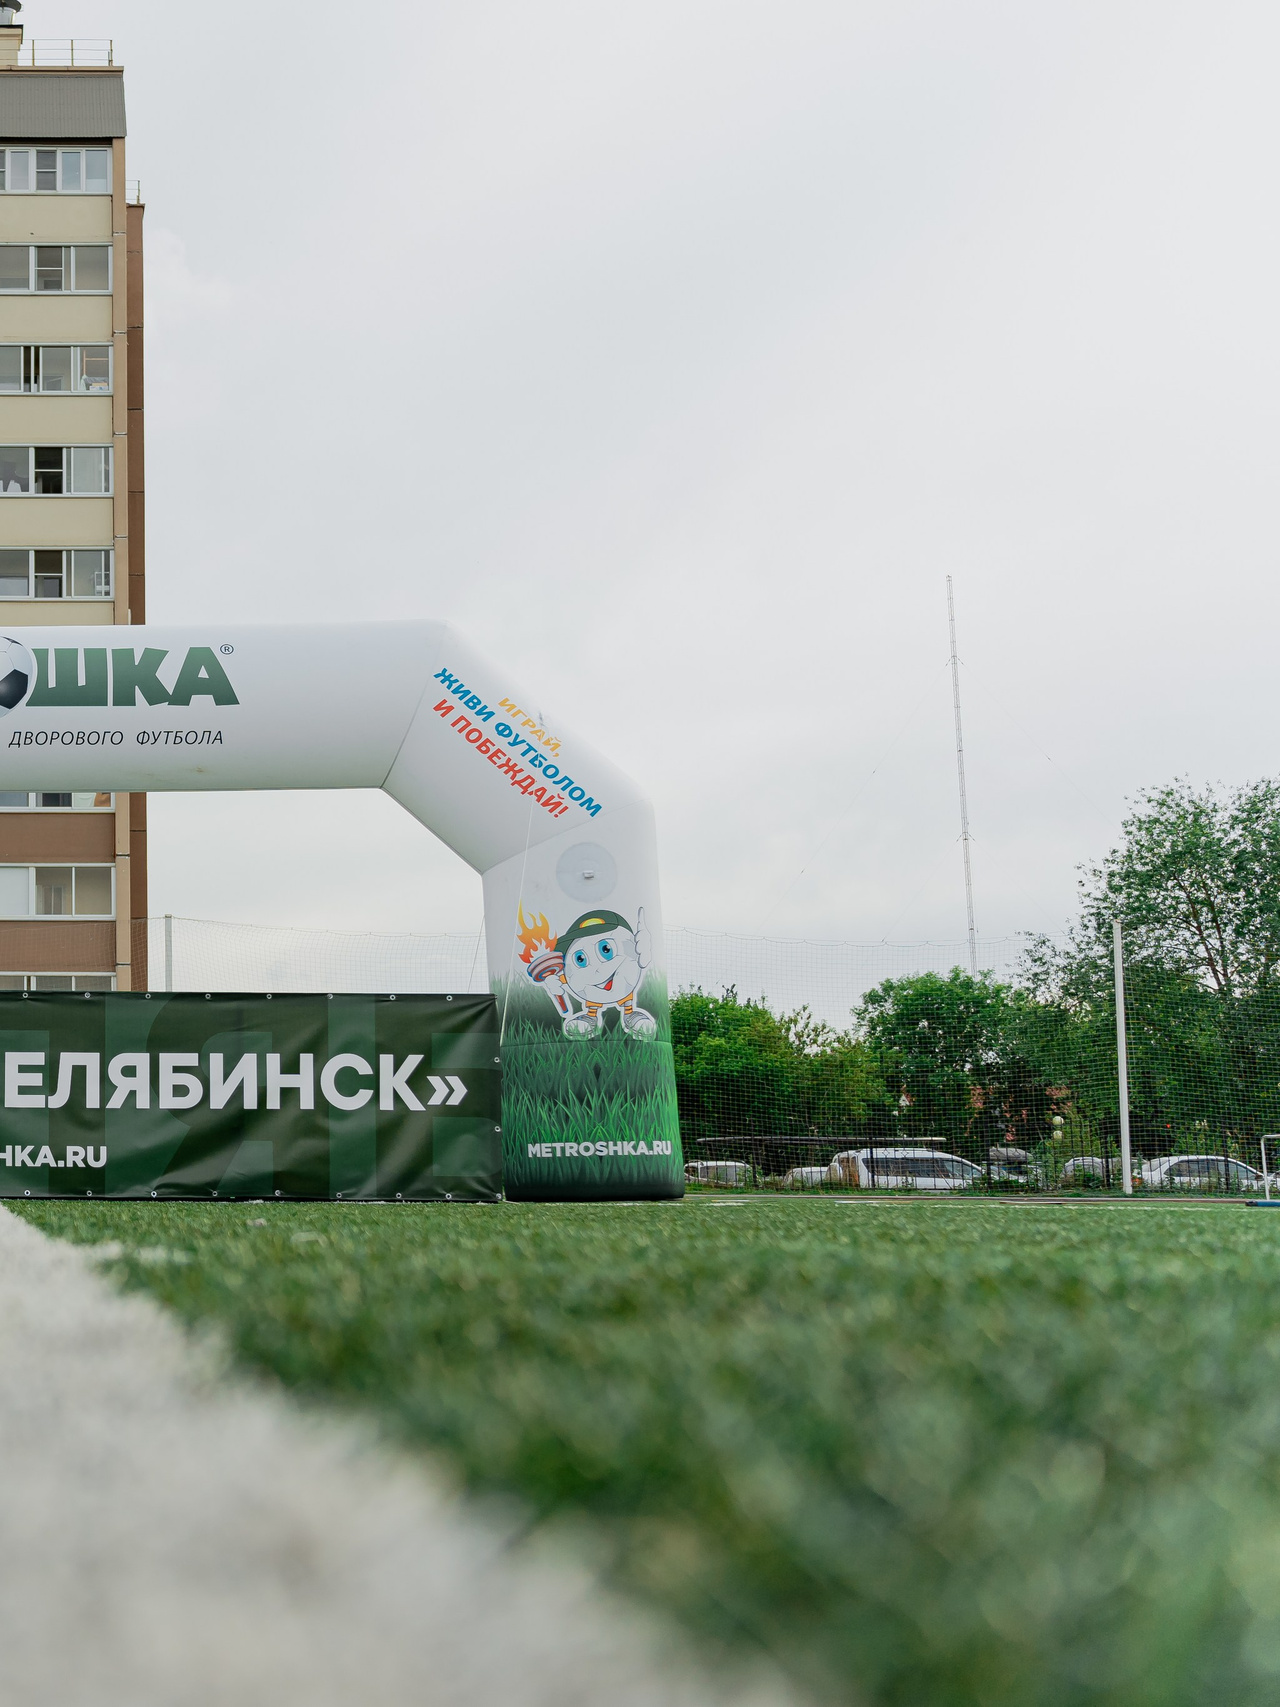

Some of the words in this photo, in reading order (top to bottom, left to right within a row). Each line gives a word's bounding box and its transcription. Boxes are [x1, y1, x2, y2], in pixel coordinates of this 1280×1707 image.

[8, 730, 124, 749] ДВОРОВОГО
[136, 730, 223, 746] ФУТБОЛА
[433, 667, 496, 723] ЖИВИ
[494, 722, 602, 818] ФУТБОЛОМ
[498, 697, 562, 758] ИГРАЙ,
[432, 698, 455, 718] И
[450, 714, 569, 819] ПОБЕЖДАЙ!
[527, 1140, 672, 1158] METROSHKA.RU
